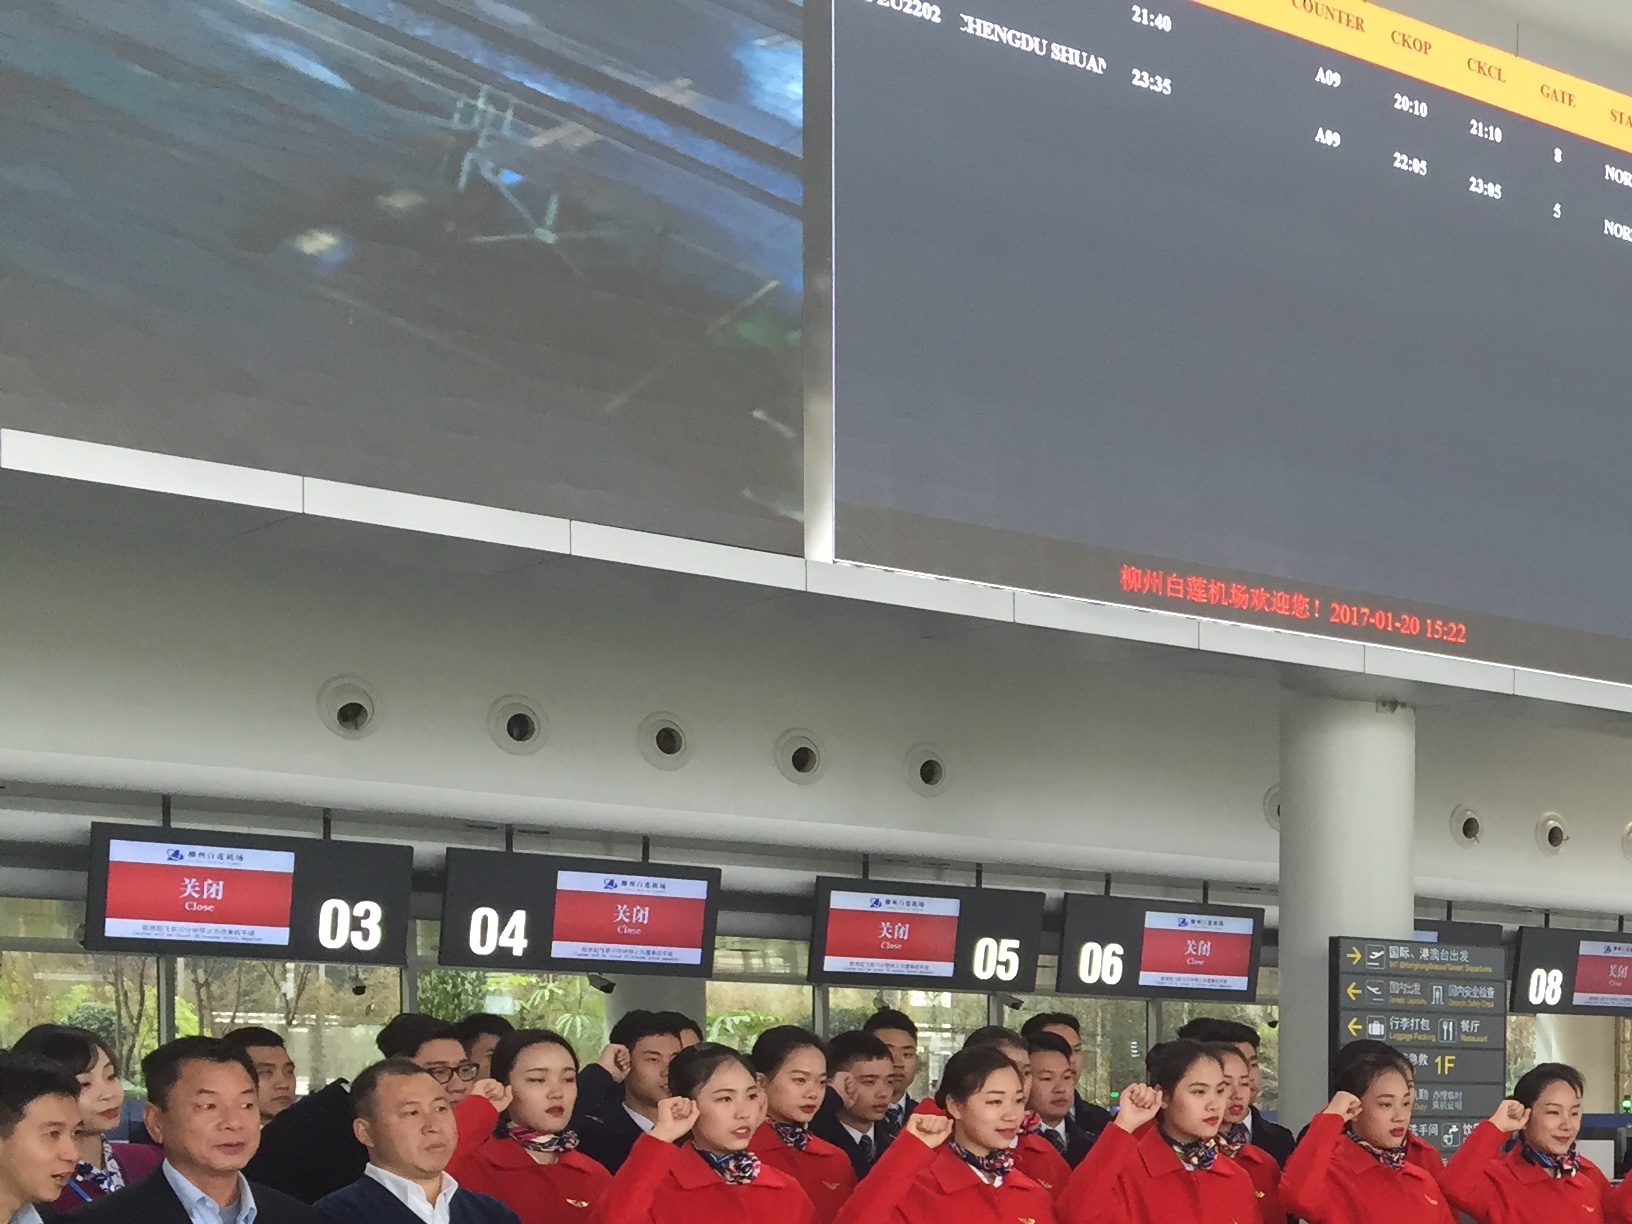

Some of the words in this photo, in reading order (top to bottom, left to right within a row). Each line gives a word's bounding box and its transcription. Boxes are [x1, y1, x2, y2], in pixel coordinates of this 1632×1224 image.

[1291, 0, 1365, 33] COUNTER
[1391, 30, 1432, 55] CKOP
[1467, 57, 1506, 83] CKCL
[1540, 84, 1576, 108] GATE
[1131, 5, 1172, 32] 21:40
[1315, 67, 1342, 88] A09
[1393, 93, 1428, 118] 20:10
[1469, 119, 1503, 143] 21:10
[1554, 147, 1563, 163] 8
[1131, 68, 1172, 95] 23:35
[1314, 127, 1342, 148] A09
[1393, 151, 1428, 176] 22:05
[1469, 176, 1502, 200] 23:05
[1553, 202, 1562, 219] 5
[1330, 602, 1420, 636] 2017-01-20
[1425, 618, 1467, 644] 15:22
[179, 877, 225, 900] 关闭
[184, 901, 215, 912] Close
[318, 898, 382, 951] 03
[468, 906, 528, 957] 04
[613, 903, 650, 925] 关闭
[878, 921, 910, 940] 关闭
[973, 937, 1021, 981] 05
[1079, 941, 1124, 985] 06
[1184, 939, 1212, 957] 关闭
[1528, 968, 1563, 1006] 08
[1389, 1015, 1431, 1031] 行李打包
[1460, 1019, 1480, 1034] 餐厅
[1435, 1055, 1456, 1076] 1F
